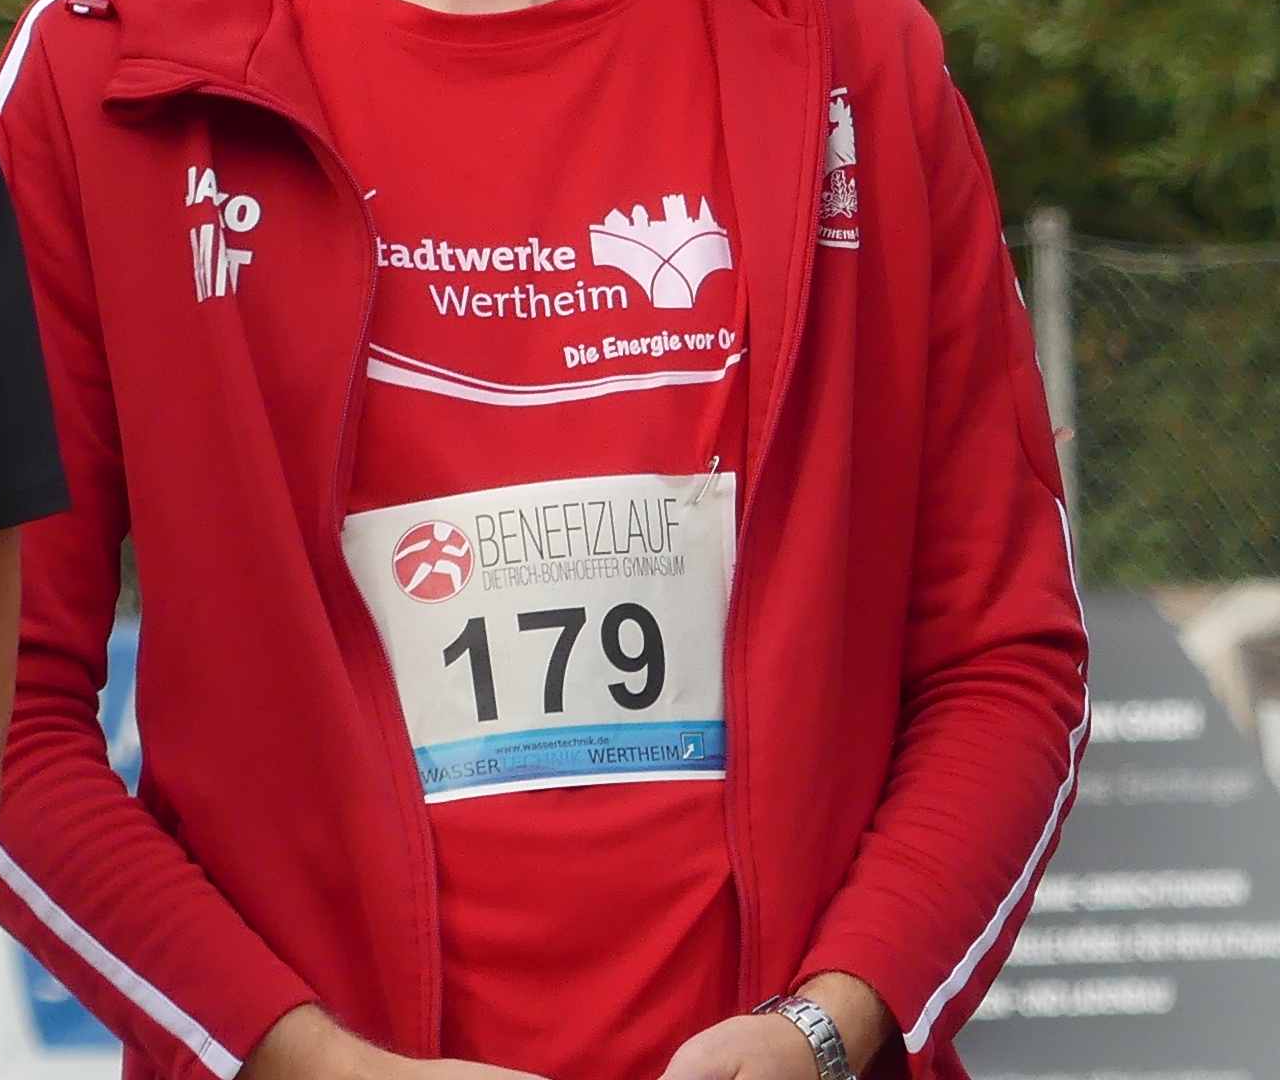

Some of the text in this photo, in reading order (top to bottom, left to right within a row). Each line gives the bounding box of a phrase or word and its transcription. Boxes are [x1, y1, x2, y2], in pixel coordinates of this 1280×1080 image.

[429, 280, 629, 319] Wertheim
[563, 343, 600, 369] Die
[602, 330, 682, 359] Energie
[683, 331, 714, 350] vor
[475, 498, 681, 566] BENEFIZLAUF
[482, 554, 686, 591] DIETRICH-BONHOEFFER GYMNASIUM
[443, 602, 666, 723] 179
[496, 736, 610, 754] www.wassertechnik.de
[588, 744, 680, 764] WERTHEIM
